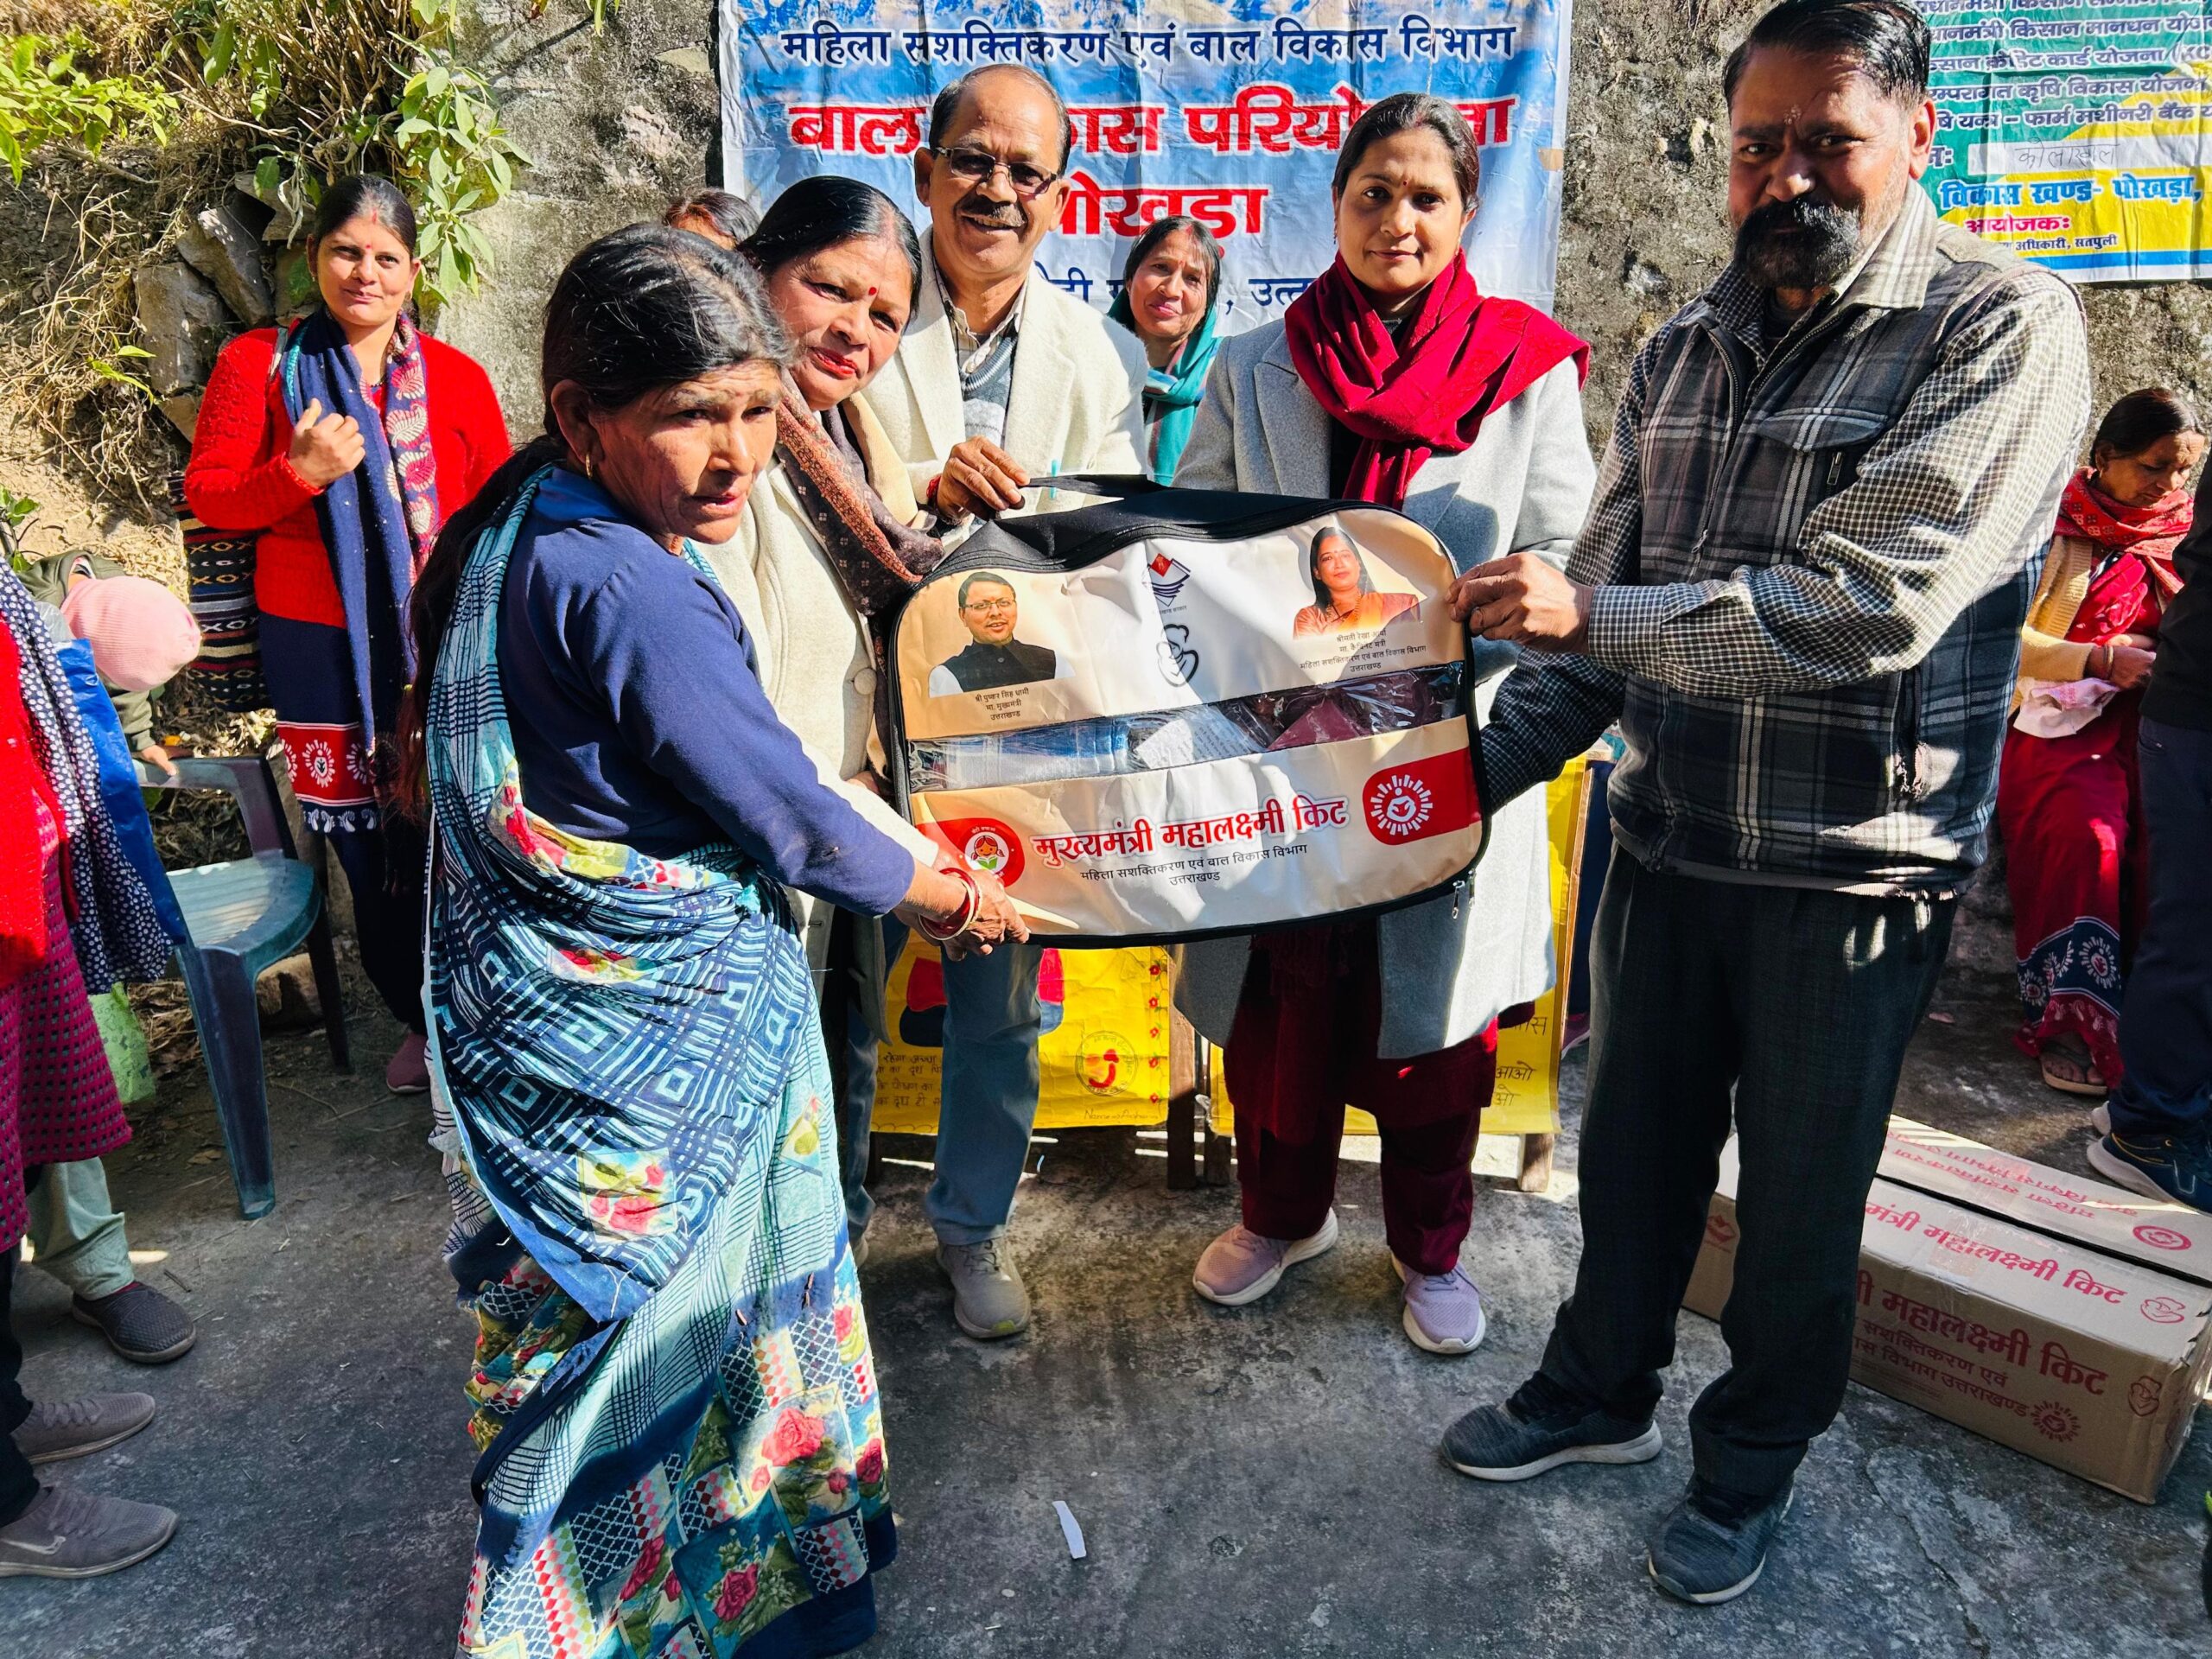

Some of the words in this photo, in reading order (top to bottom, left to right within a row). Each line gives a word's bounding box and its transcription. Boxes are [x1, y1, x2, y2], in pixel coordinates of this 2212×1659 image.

[781, 19, 891, 64] महिला
[903, 19, 1109, 64] सशक्तिकरण
[1121, 22, 1175, 68] एवं
[1187, 30, 1261, 61] बाल
[1273, 17, 1388, 60] विकास
[1400, 14, 1516, 60] विभाग
[2010, 19, 2081, 37] किसान
[2047, 48, 2091, 67] कार्ड
[2095, 46, 2164, 63] योजना
[2018, 78, 2062, 103] कृषि
[2068, 76, 2135, 95] विकास
[788, 106, 926, 154] बाल
[2024, 105, 2072, 126] फार्म
[2075, 103, 2153, 124] मशीनरी
[1940, 180, 2022, 208] विकास
[2075, 234, 2117, 250] सतपुली
[1032, 817, 1153, 867] मुख्यमंत्री
[1160, 798, 1285, 849] महालक्ष्मी
[1292, 794, 1346, 831] किट
[1080, 867, 1113, 881] महिला
[1116, 861, 1185, 879] सशक्तिकरण
[1188, 858, 1205, 870] एवं
[1208, 856, 1229, 868] बाल
[1233, 848, 1269, 865] विकास
[1272, 843, 1307, 859] विभाग
[1169, 870, 1220, 886] उत्तराखण्ड
[1923, 1224, 2061, 1281] महालक्ष्मी
[2062, 1268, 2129, 1305] किट
[1863, 1319, 1975, 1376] सशक्तिकरण
[1979, 1365, 2008, 1388] एवं
[1881, 1288, 2032, 1368] महालक्ष्मी
[2037, 1341, 2109, 1396] किट
[1882, 1339, 1938, 1382] विभाग
[1941, 1370, 2031, 1418] उत्तराखण्ड
